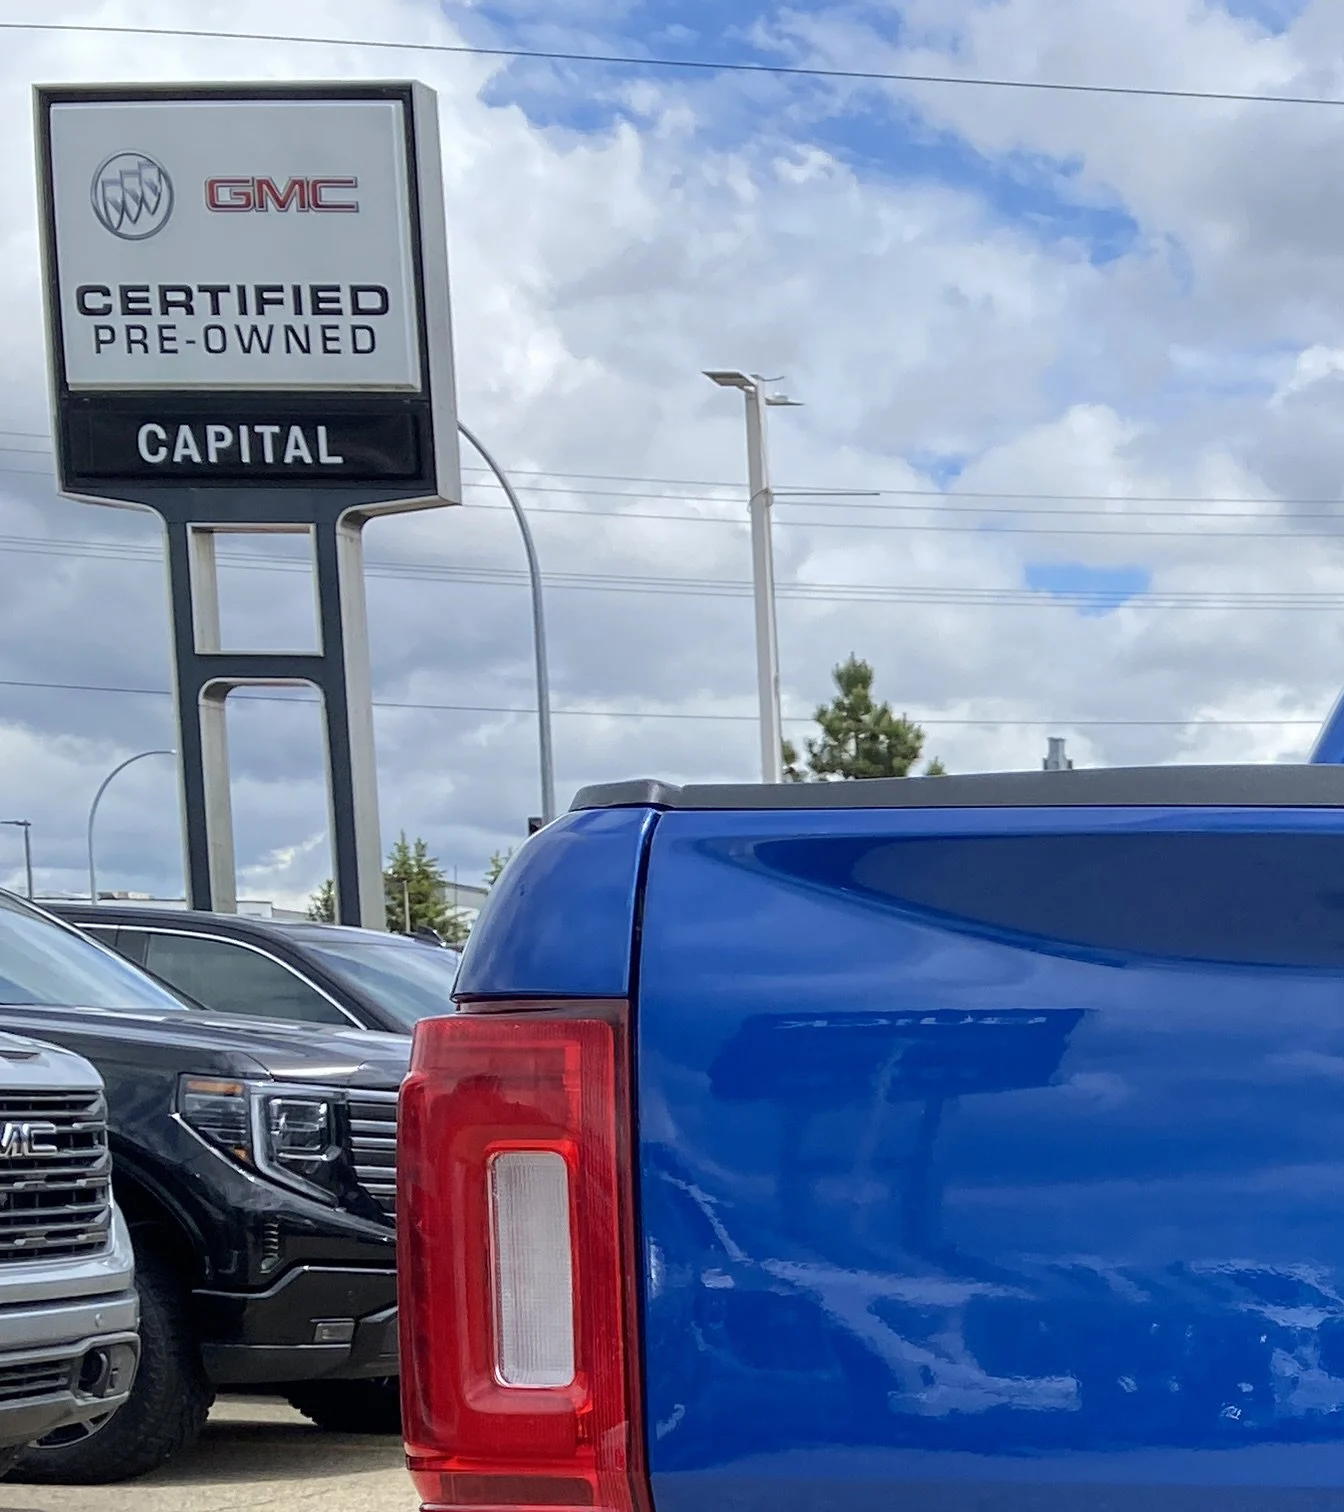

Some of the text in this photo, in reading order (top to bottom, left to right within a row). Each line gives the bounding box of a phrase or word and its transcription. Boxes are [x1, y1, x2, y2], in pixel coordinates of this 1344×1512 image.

[206, 176, 358, 213] GMC
[76, 285, 390, 316] CERTIFIED
[95, 324, 376, 354] PRE-OWNED
[137, 424, 344, 464] CAPITAL
